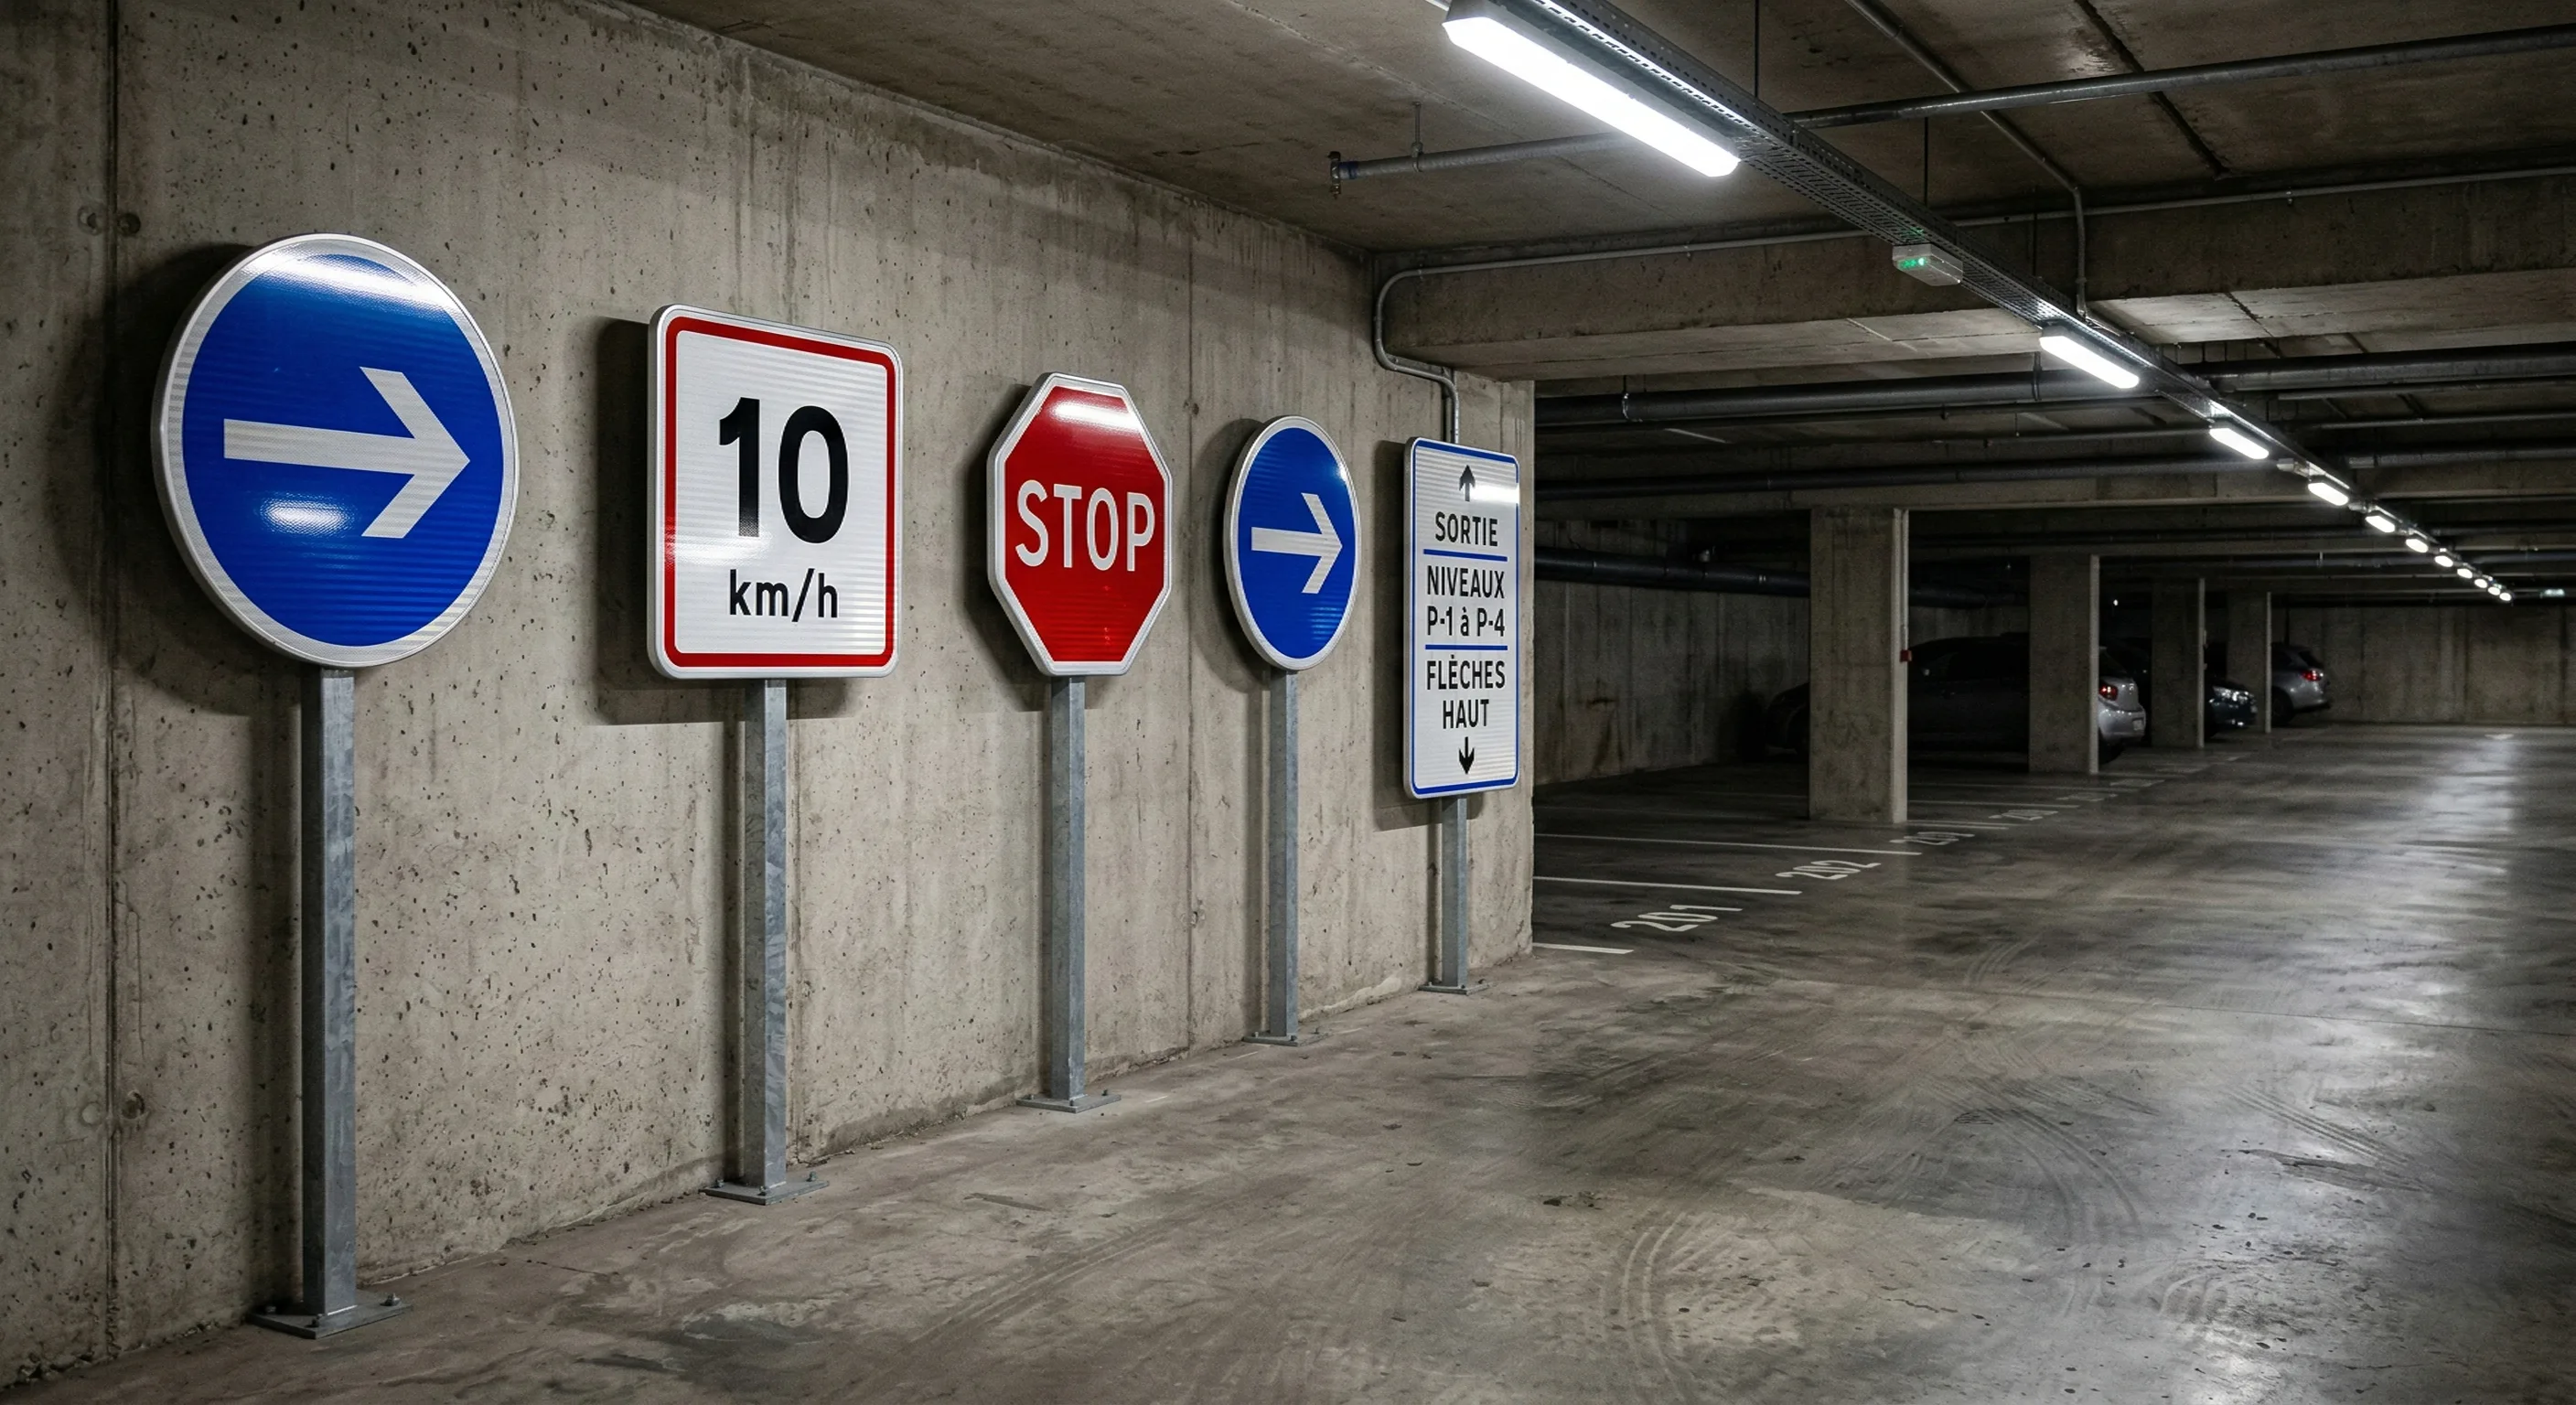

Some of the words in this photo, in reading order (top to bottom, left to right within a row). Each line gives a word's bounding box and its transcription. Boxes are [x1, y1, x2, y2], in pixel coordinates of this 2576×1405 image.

[718, 396, 849, 544] 10
[1015, 479, 1155, 572] STOP
[1434, 511, 1498, 546] SORTIE
[729, 568, 839, 623] km/h
[1427, 565, 1505, 599] NIVEAUX
[1427, 606, 1453, 636] P-1
[1460, 606, 1469, 637] à
[1476, 607, 1505, 637] P-4
[1443, 699, 1489, 729] HAUT
[1775, 860, 1882, 880] 202
[1610, 905, 1744, 932] 201
